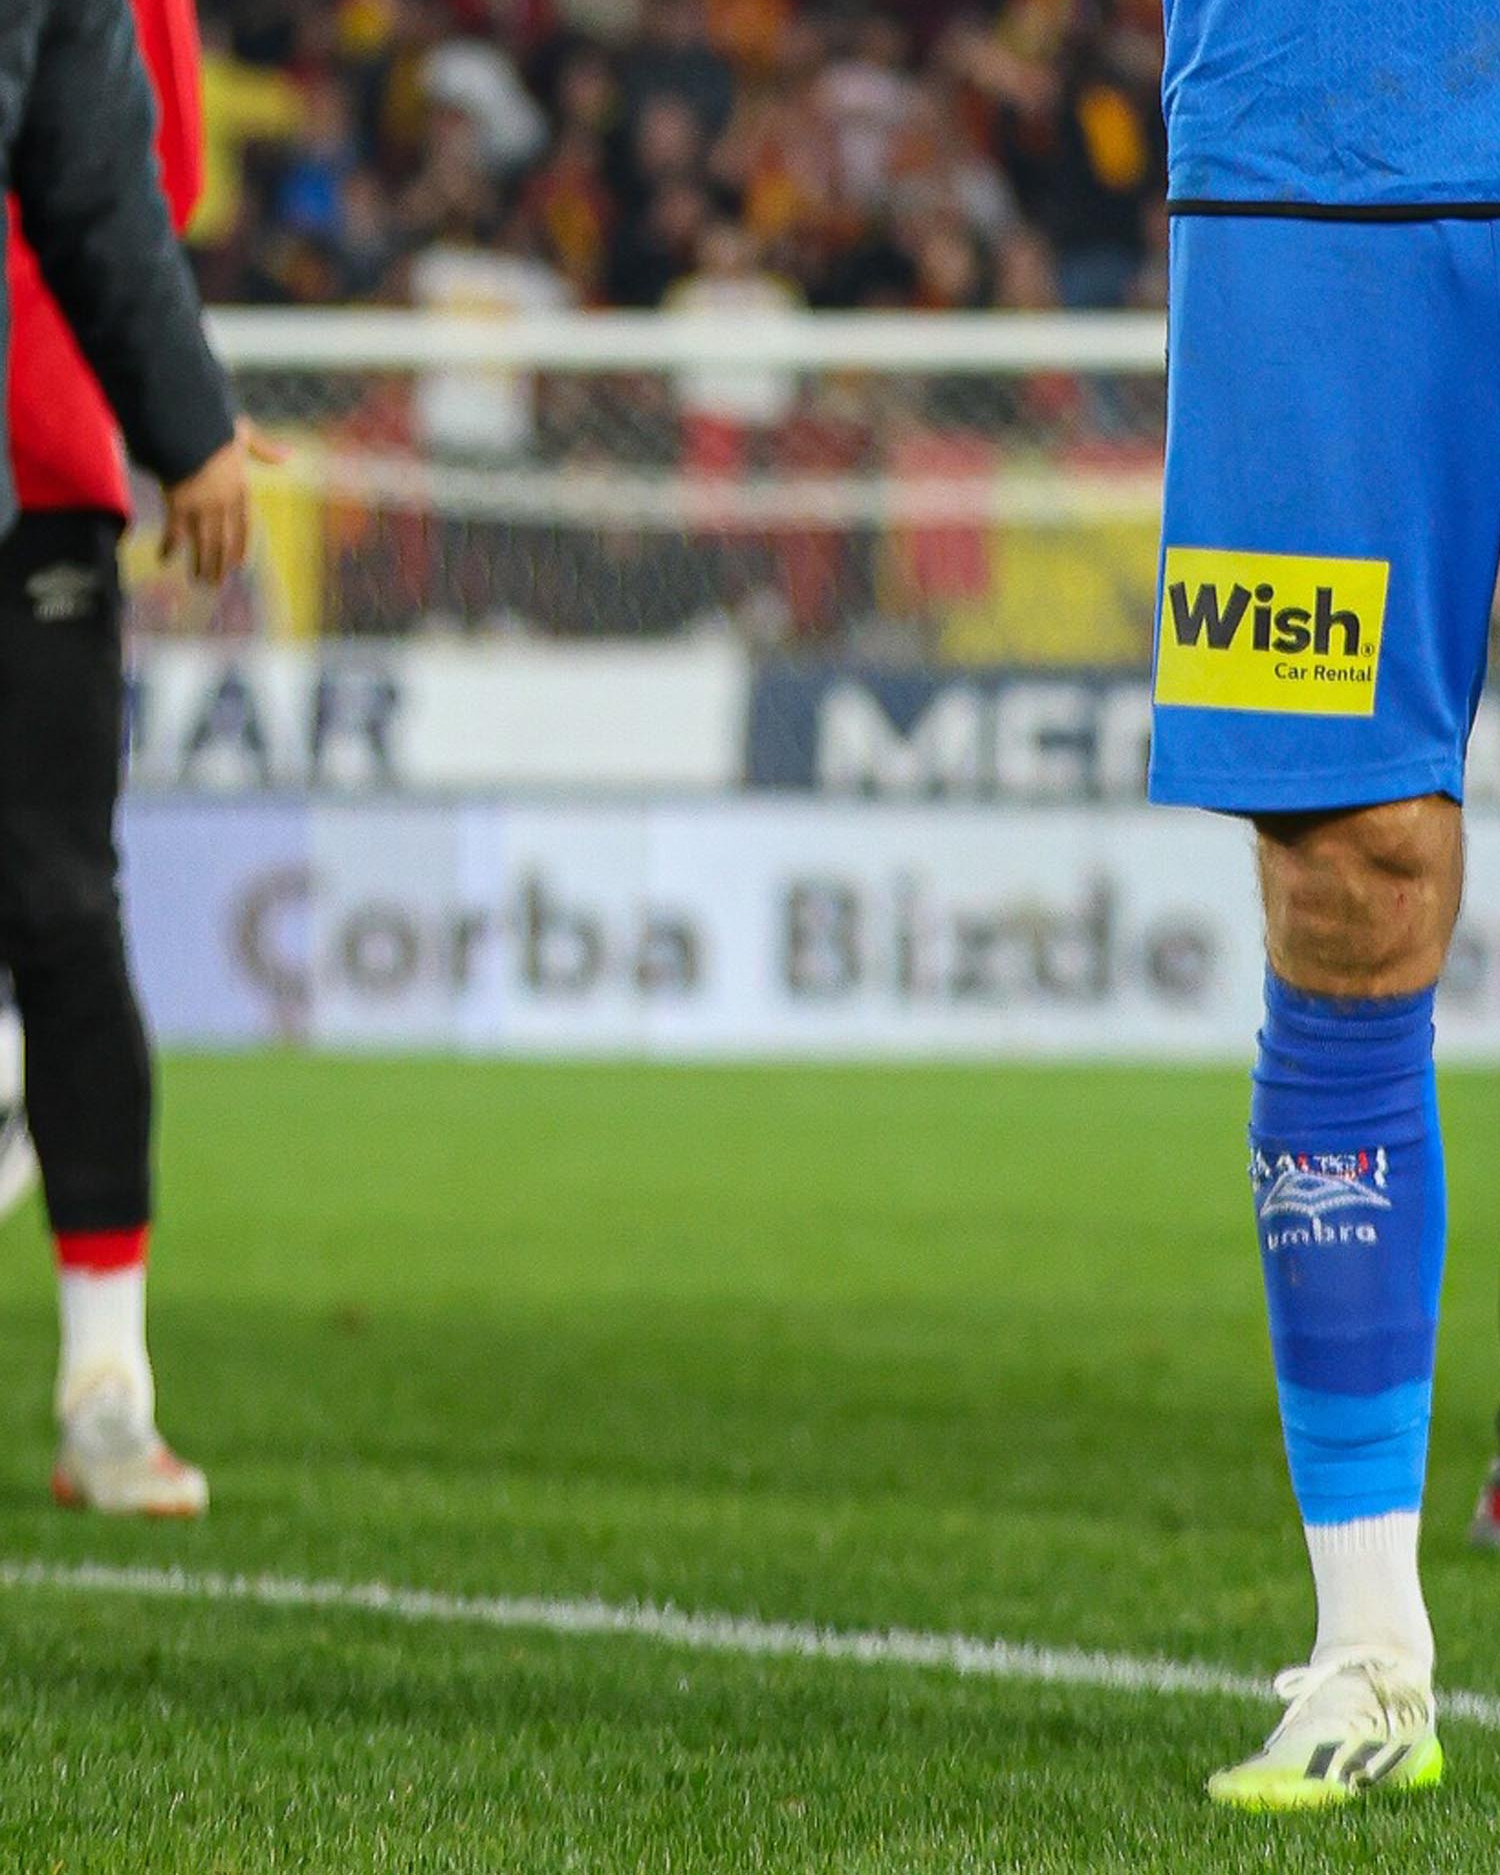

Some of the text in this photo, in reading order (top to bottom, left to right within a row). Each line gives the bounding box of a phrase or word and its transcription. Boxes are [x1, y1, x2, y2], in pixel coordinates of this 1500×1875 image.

[1167, 580, 1361, 657] Wish
[1274, 662, 1372, 683] Car Rental
